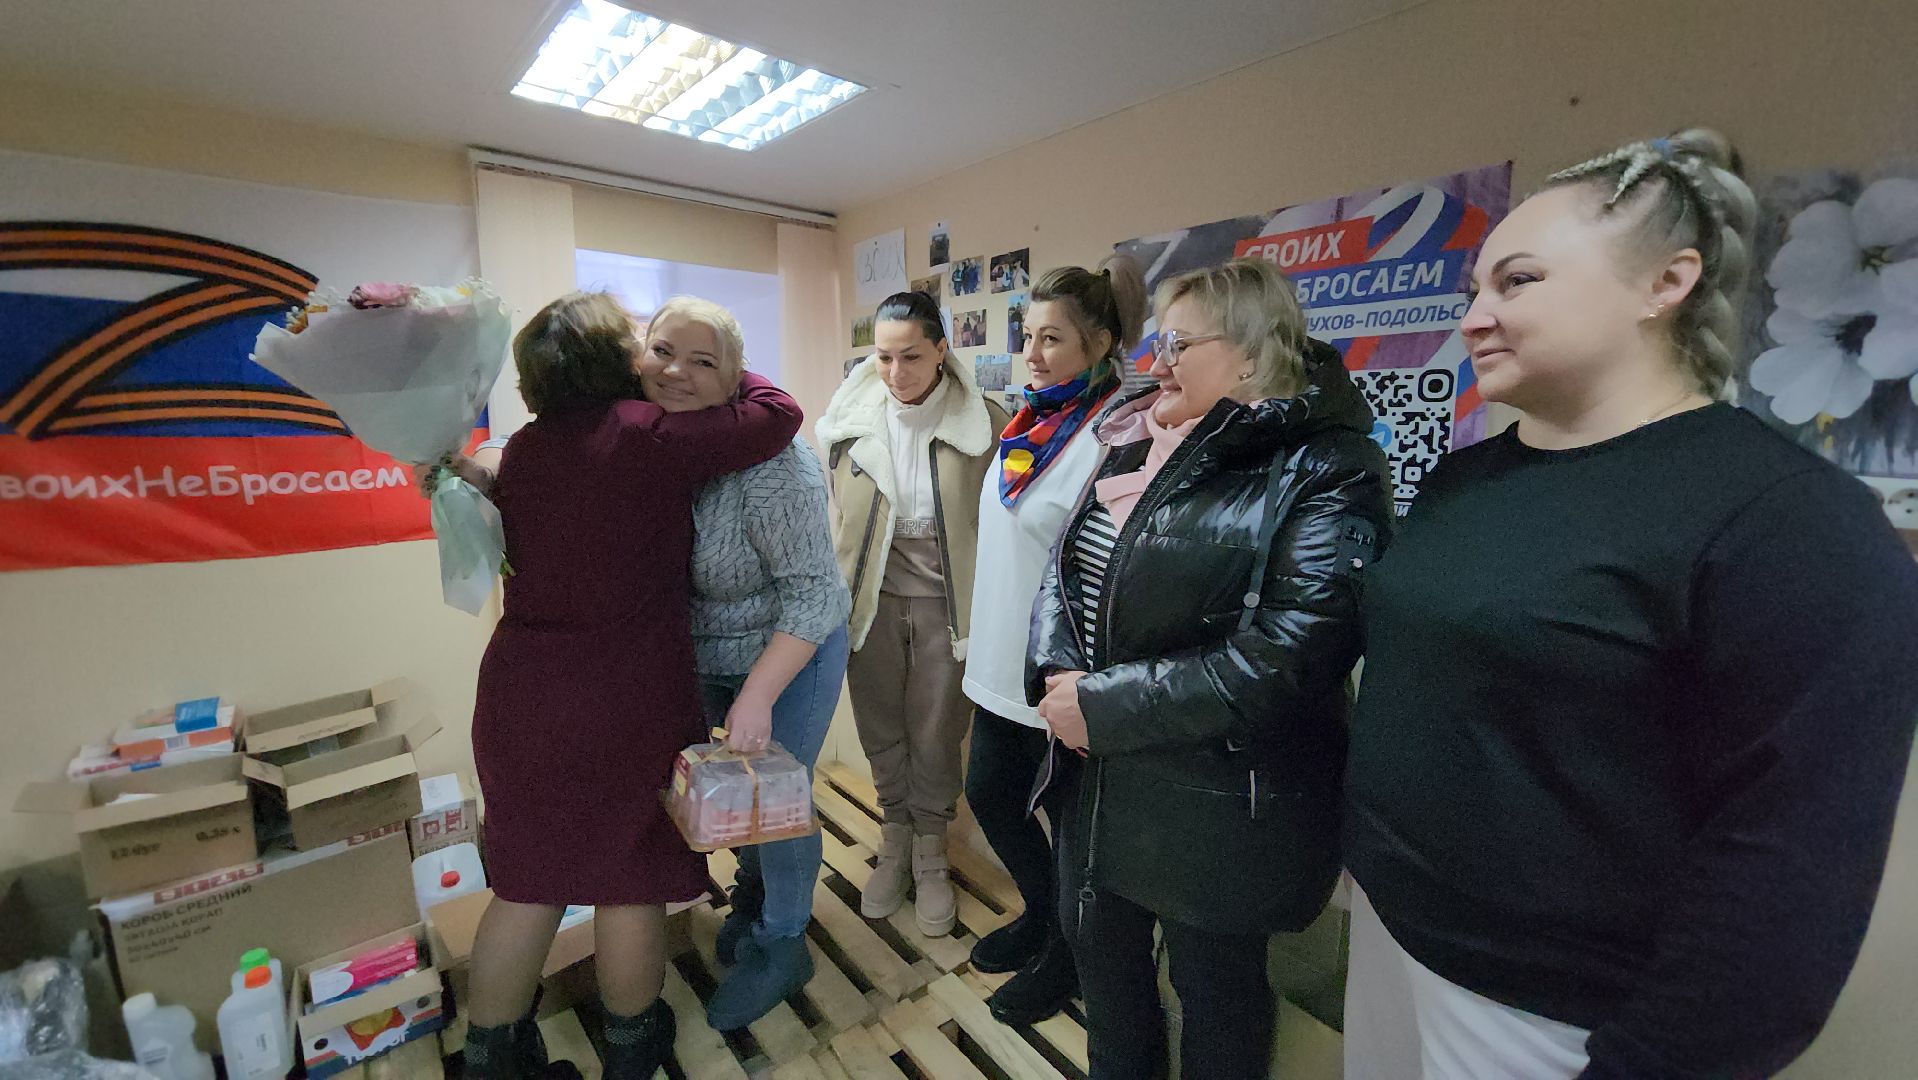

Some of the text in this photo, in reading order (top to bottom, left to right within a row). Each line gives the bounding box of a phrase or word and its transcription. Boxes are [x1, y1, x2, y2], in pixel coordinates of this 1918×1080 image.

[1296, 259, 1444, 303] БРОСАЕМ
[1305, 302, 1470, 332] УХОВ-ПОДОЛЬС
[121, 910, 173, 930] КОРОБ
[176, 883, 252, 914] СРЕДНИЙ
